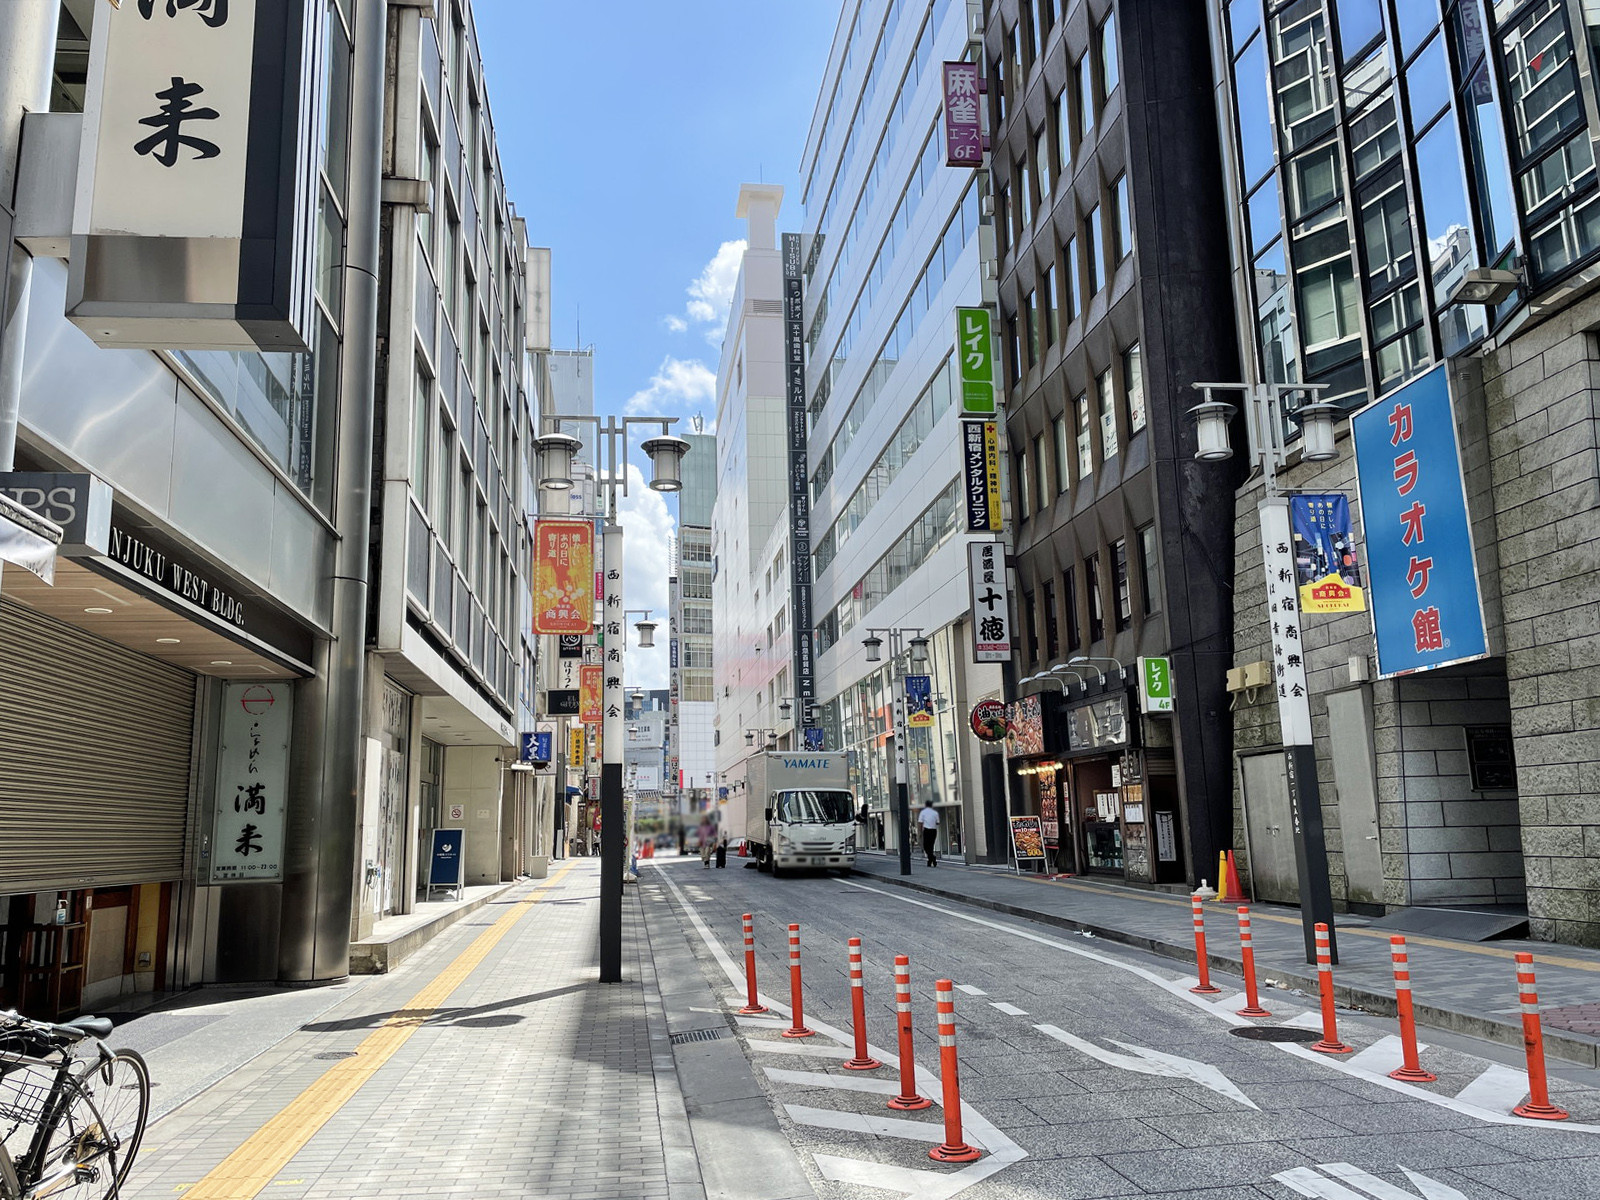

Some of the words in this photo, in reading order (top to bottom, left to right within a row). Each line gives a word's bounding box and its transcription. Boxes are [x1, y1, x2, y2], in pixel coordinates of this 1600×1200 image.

[947, 69, 977, 124] 麻雀
[949, 128, 979, 141] エース
[954, 145, 977, 159] 6F
[965, 316, 984, 370] レイク
[967, 424, 985, 527] 西新宿メンタルクリニック
[1388, 402, 1443, 654] カラオケ館
[560, 533, 569, 566] あの日に
[982, 545, 995, 583] 居酒屋
[172, 562, 208, 607] WEST
[211, 586, 245, 626] BLDG.
[545, 609, 581, 620] 商興会
[1276, 542, 1305, 698] 西新宿商興会
[606, 569, 621, 719] 西新宿商興会
[1151, 662, 1161, 691] レイク
[1158, 699, 1170, 710] 4F
[526, 734, 540, 760] 大黒
[783, 758, 830, 769] YAMATE
[234, 782, 266, 857] 満来
